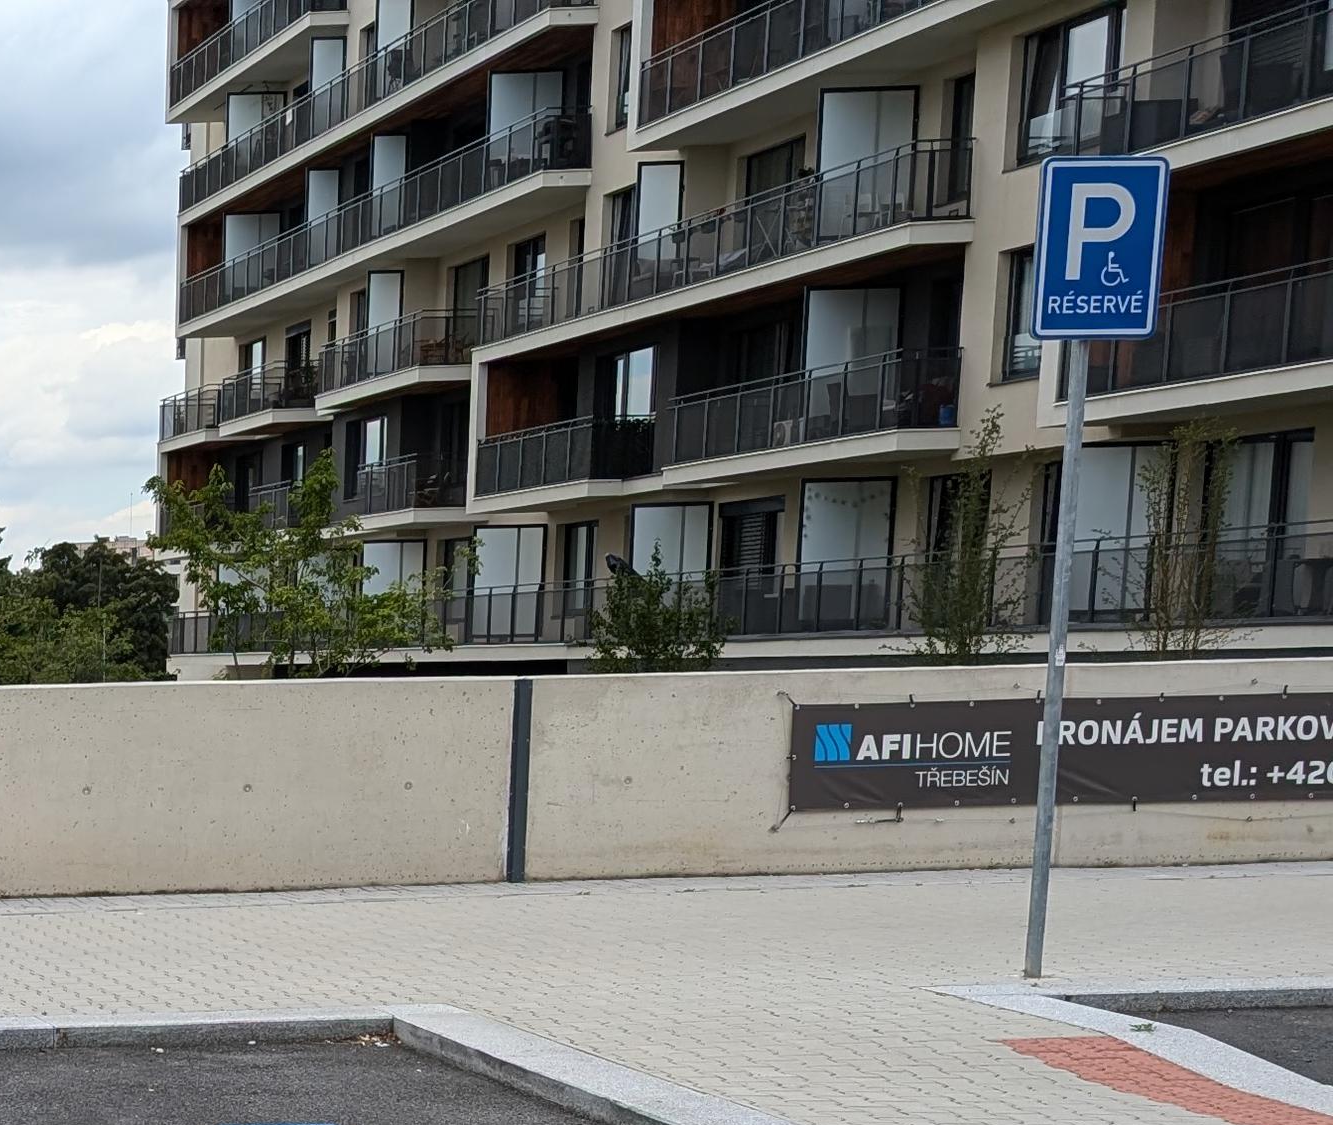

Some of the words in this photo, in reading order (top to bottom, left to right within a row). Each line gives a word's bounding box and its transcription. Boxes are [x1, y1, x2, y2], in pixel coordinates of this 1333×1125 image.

[1065, 182, 1136, 281] P
[1047, 289, 1144, 314] RÉSERVÉ
[914, 765, 1010, 788] TŘEBEŠÍN
[1200, 760, 1257, 787] tel.:
